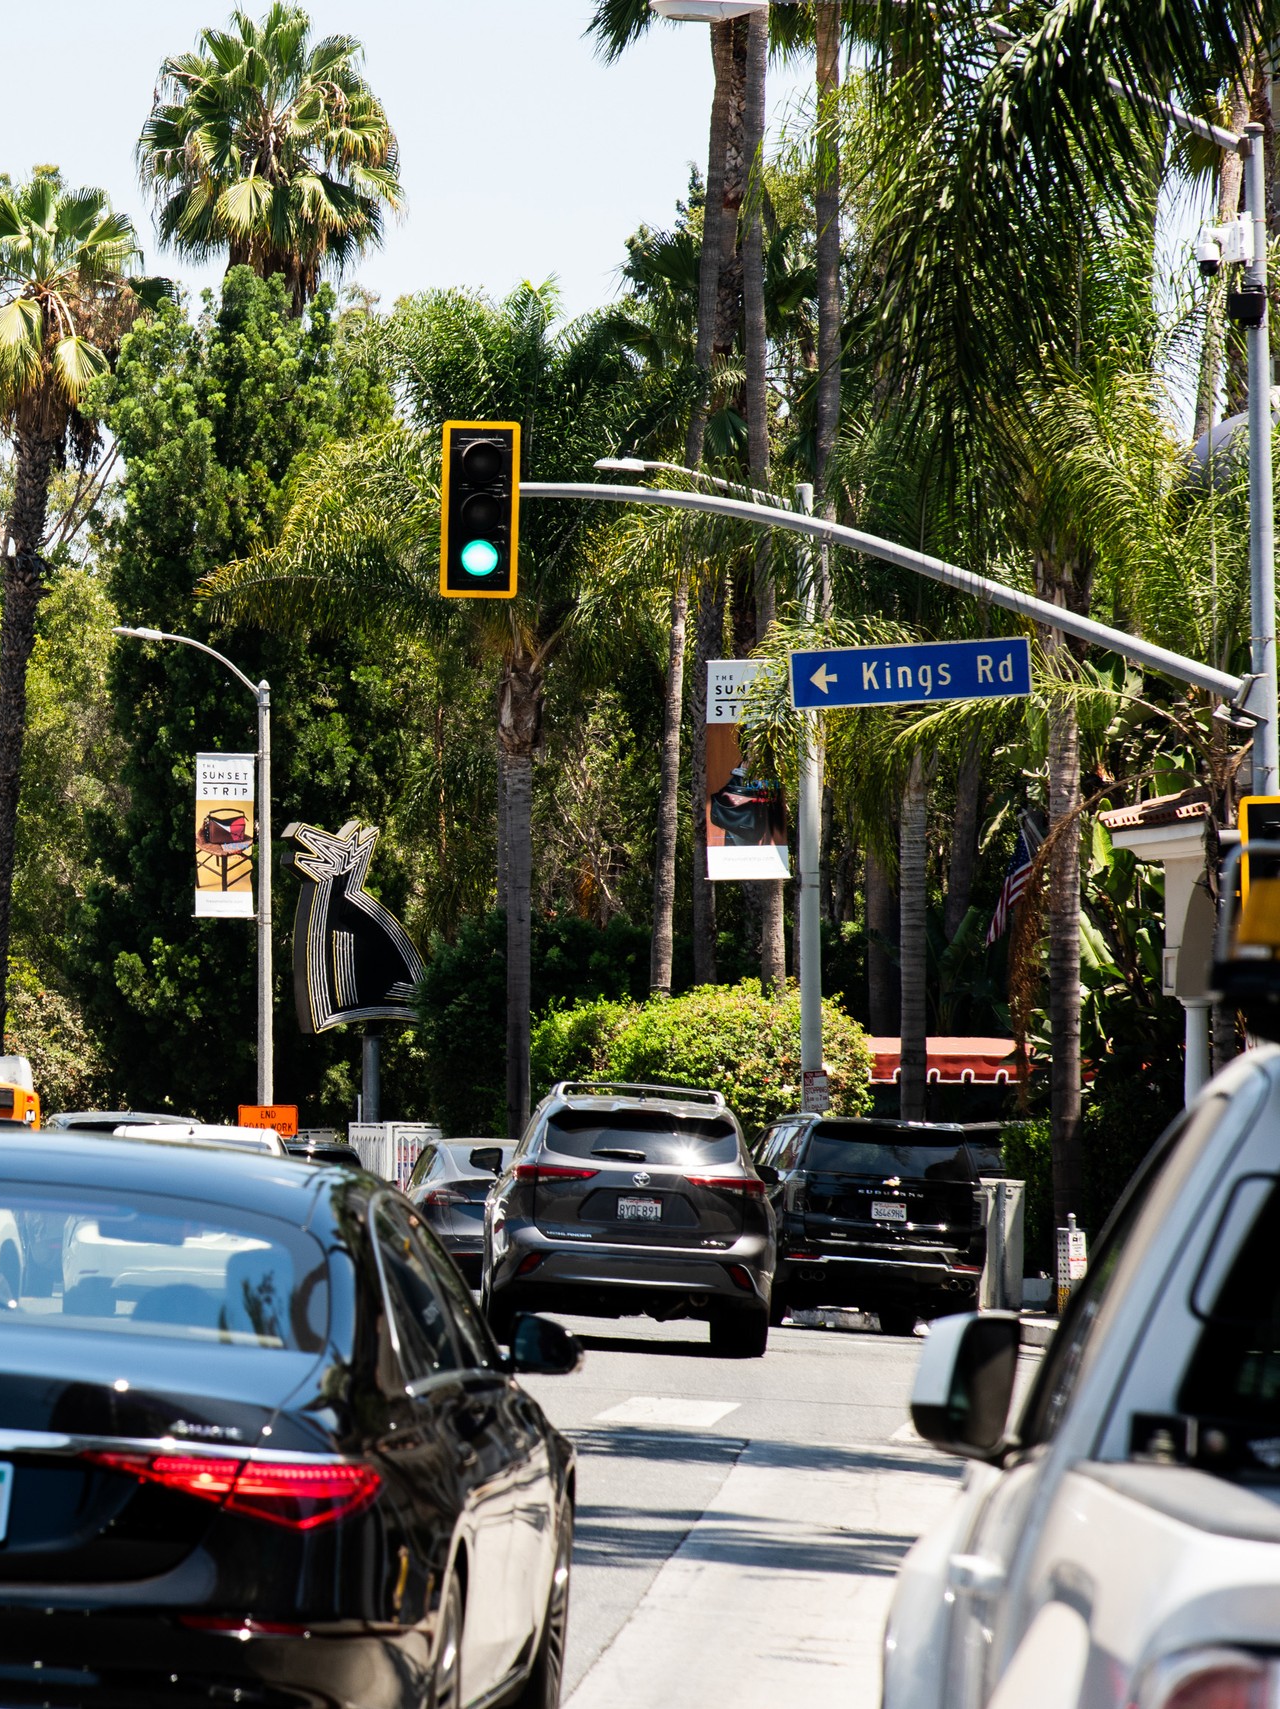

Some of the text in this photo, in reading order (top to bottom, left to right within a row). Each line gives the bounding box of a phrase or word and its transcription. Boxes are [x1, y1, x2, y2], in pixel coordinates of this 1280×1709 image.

[862, 653, 1013, 696] Kings Rd
[202, 771, 248, 780] SUNSET
[202, 787, 248, 796] STRIP
[260, 1110, 277, 1119] END
[271, 1122, 293, 1132] WORK
